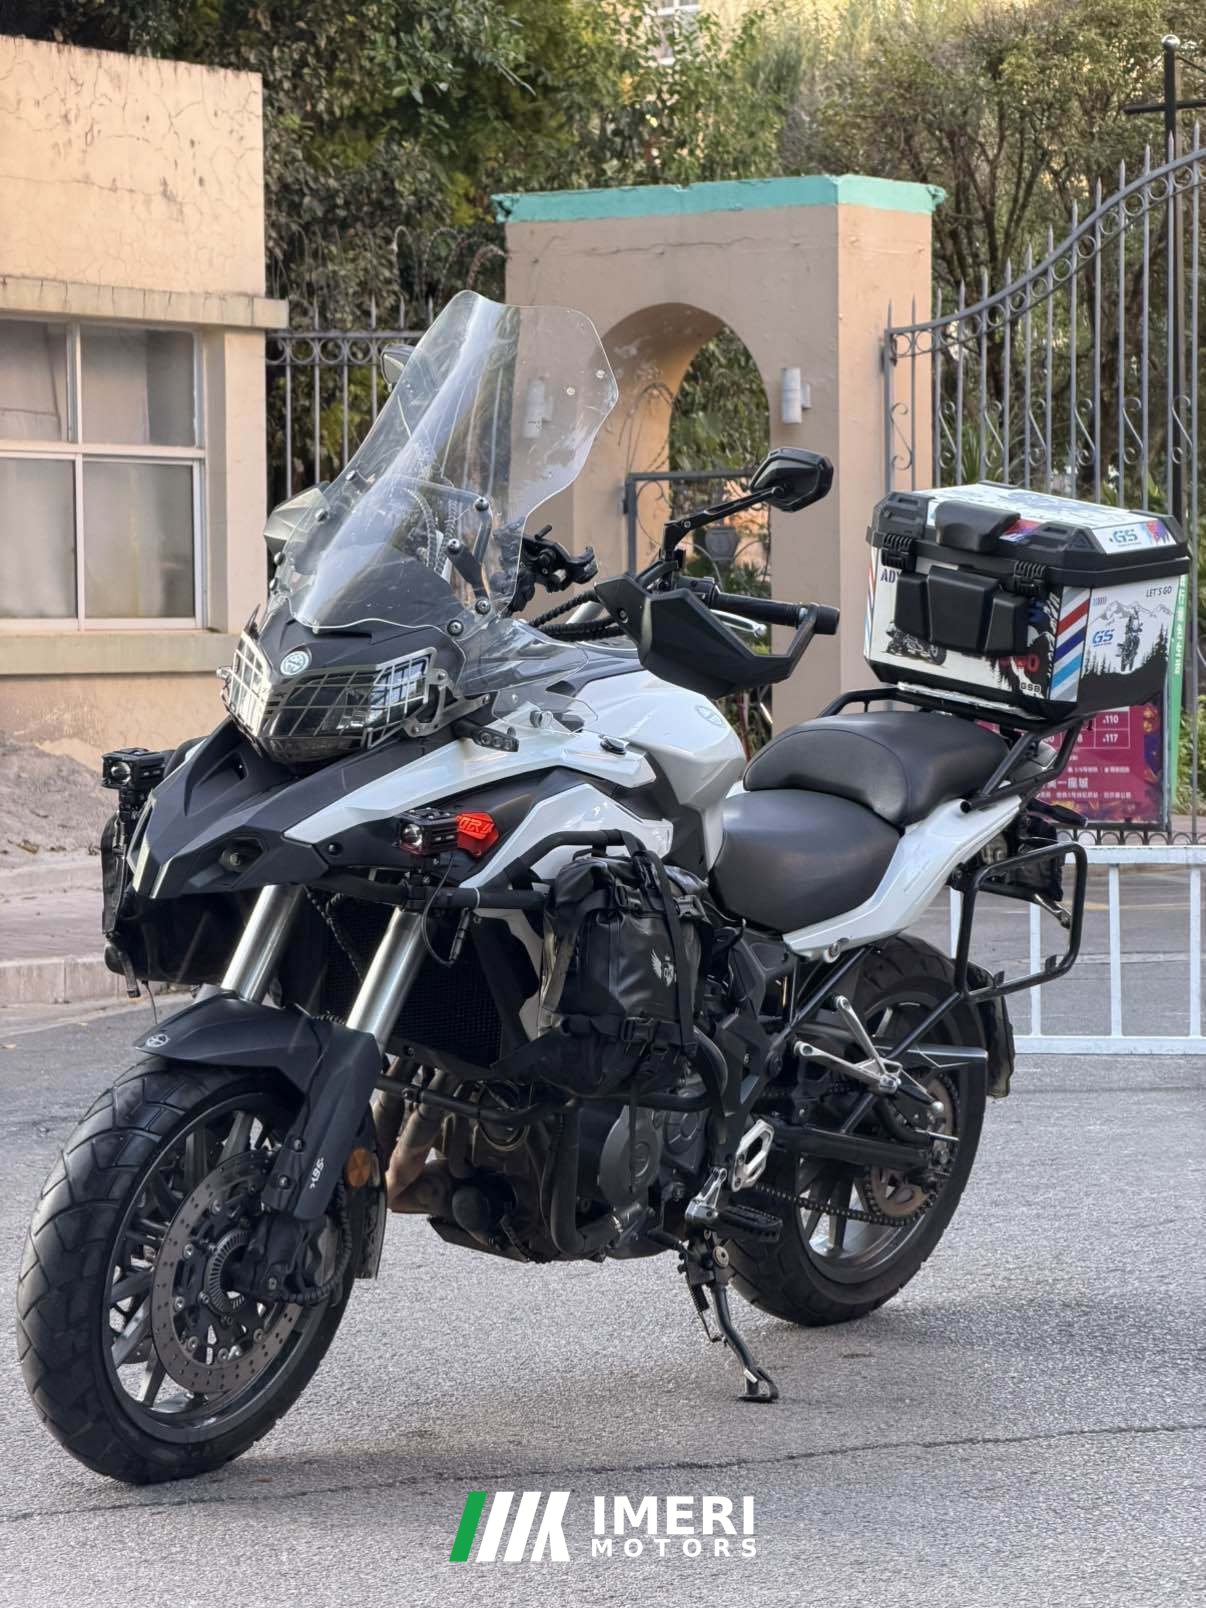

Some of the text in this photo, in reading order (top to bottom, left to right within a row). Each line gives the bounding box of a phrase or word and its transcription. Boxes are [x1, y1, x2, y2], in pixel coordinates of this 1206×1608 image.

[1114, 528, 1139, 544] GS
[1146, 586, 1173, 598] LET'S GO
[1092, 629, 1116, 644] GS
